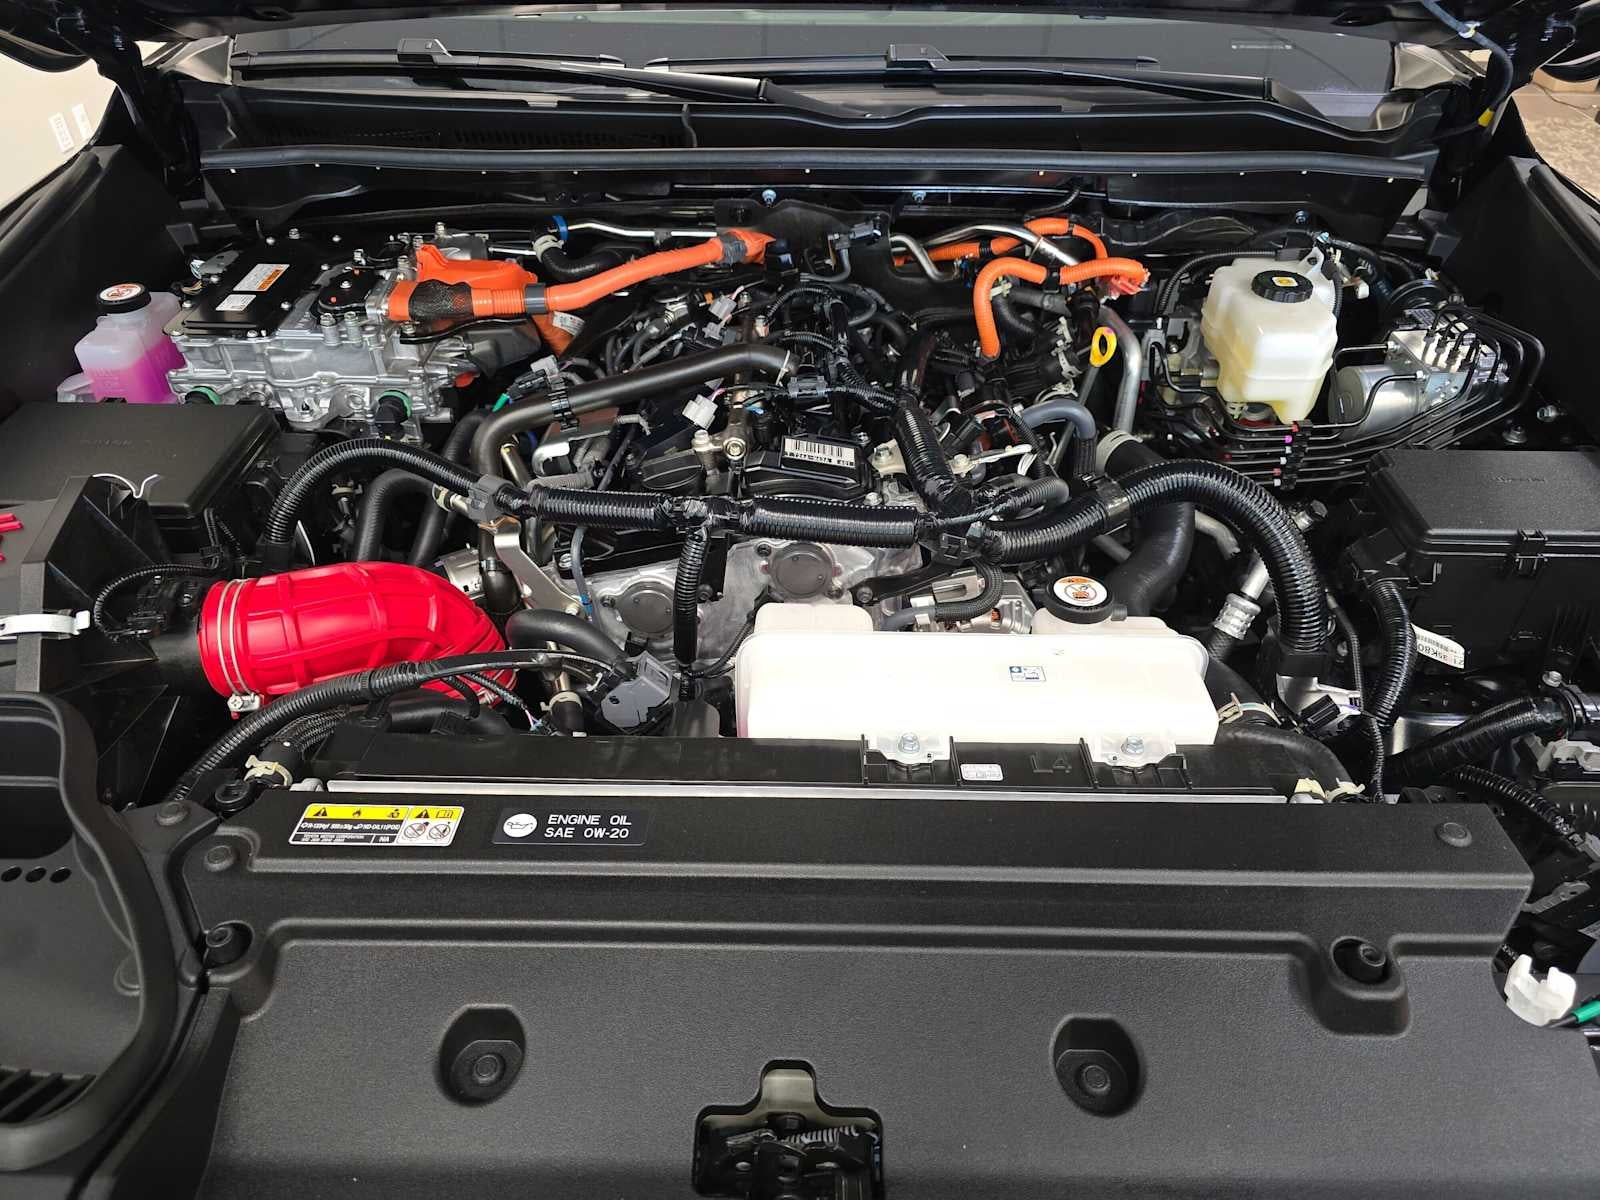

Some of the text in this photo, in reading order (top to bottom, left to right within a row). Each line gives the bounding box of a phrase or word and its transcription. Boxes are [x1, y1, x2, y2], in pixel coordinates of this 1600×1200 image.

[547, 814, 632, 825] ENGINE OIL
[544, 827, 629, 838] SAE 0W-20
